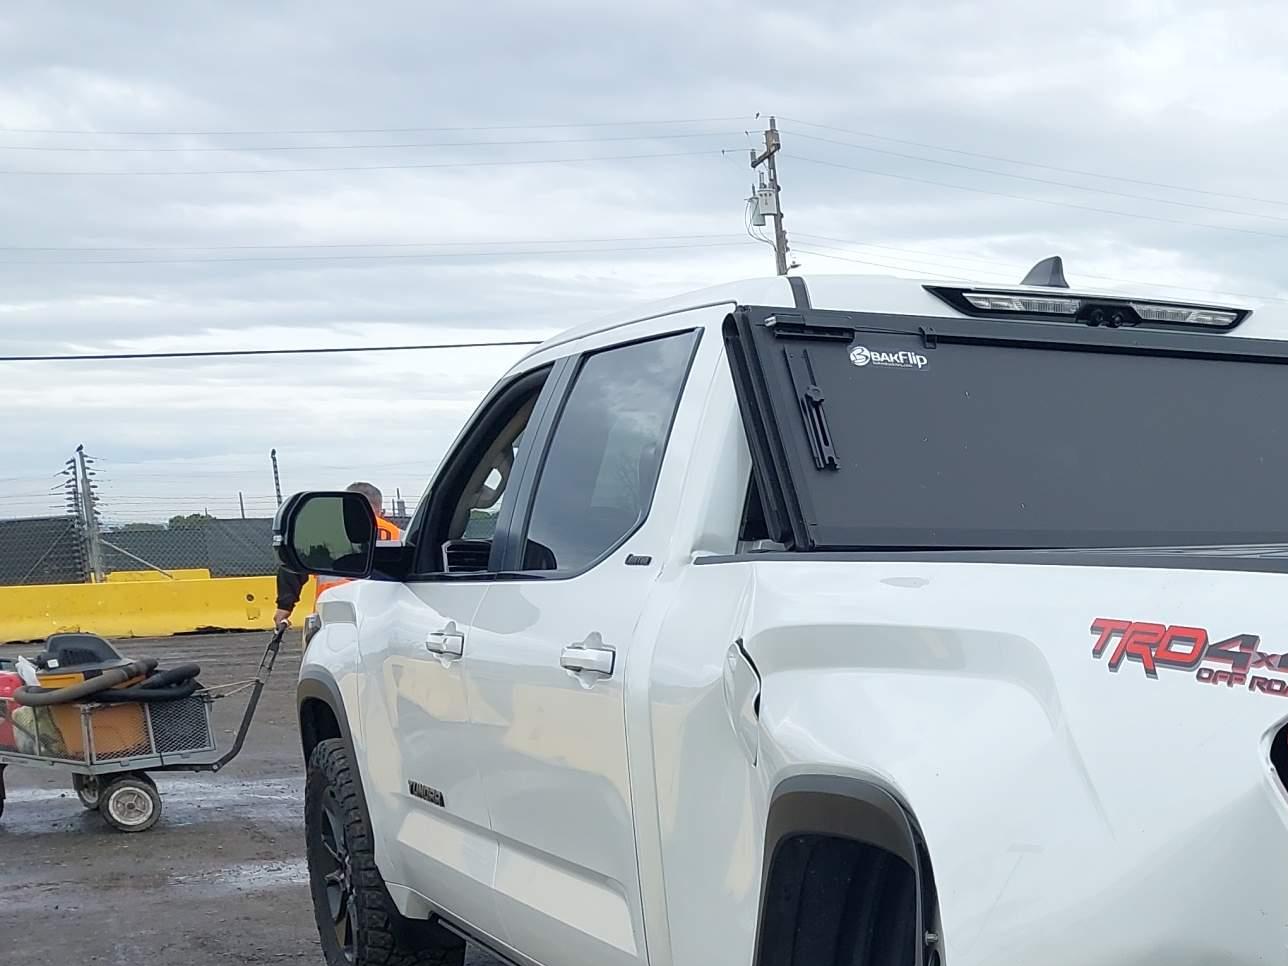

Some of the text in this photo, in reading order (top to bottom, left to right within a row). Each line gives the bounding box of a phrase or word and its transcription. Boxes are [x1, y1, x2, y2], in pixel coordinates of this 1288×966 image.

[1090, 617, 1209, 680] TRD
[1196, 667, 1248, 687] OFF
[407, 779, 446, 808] TUNDRA
